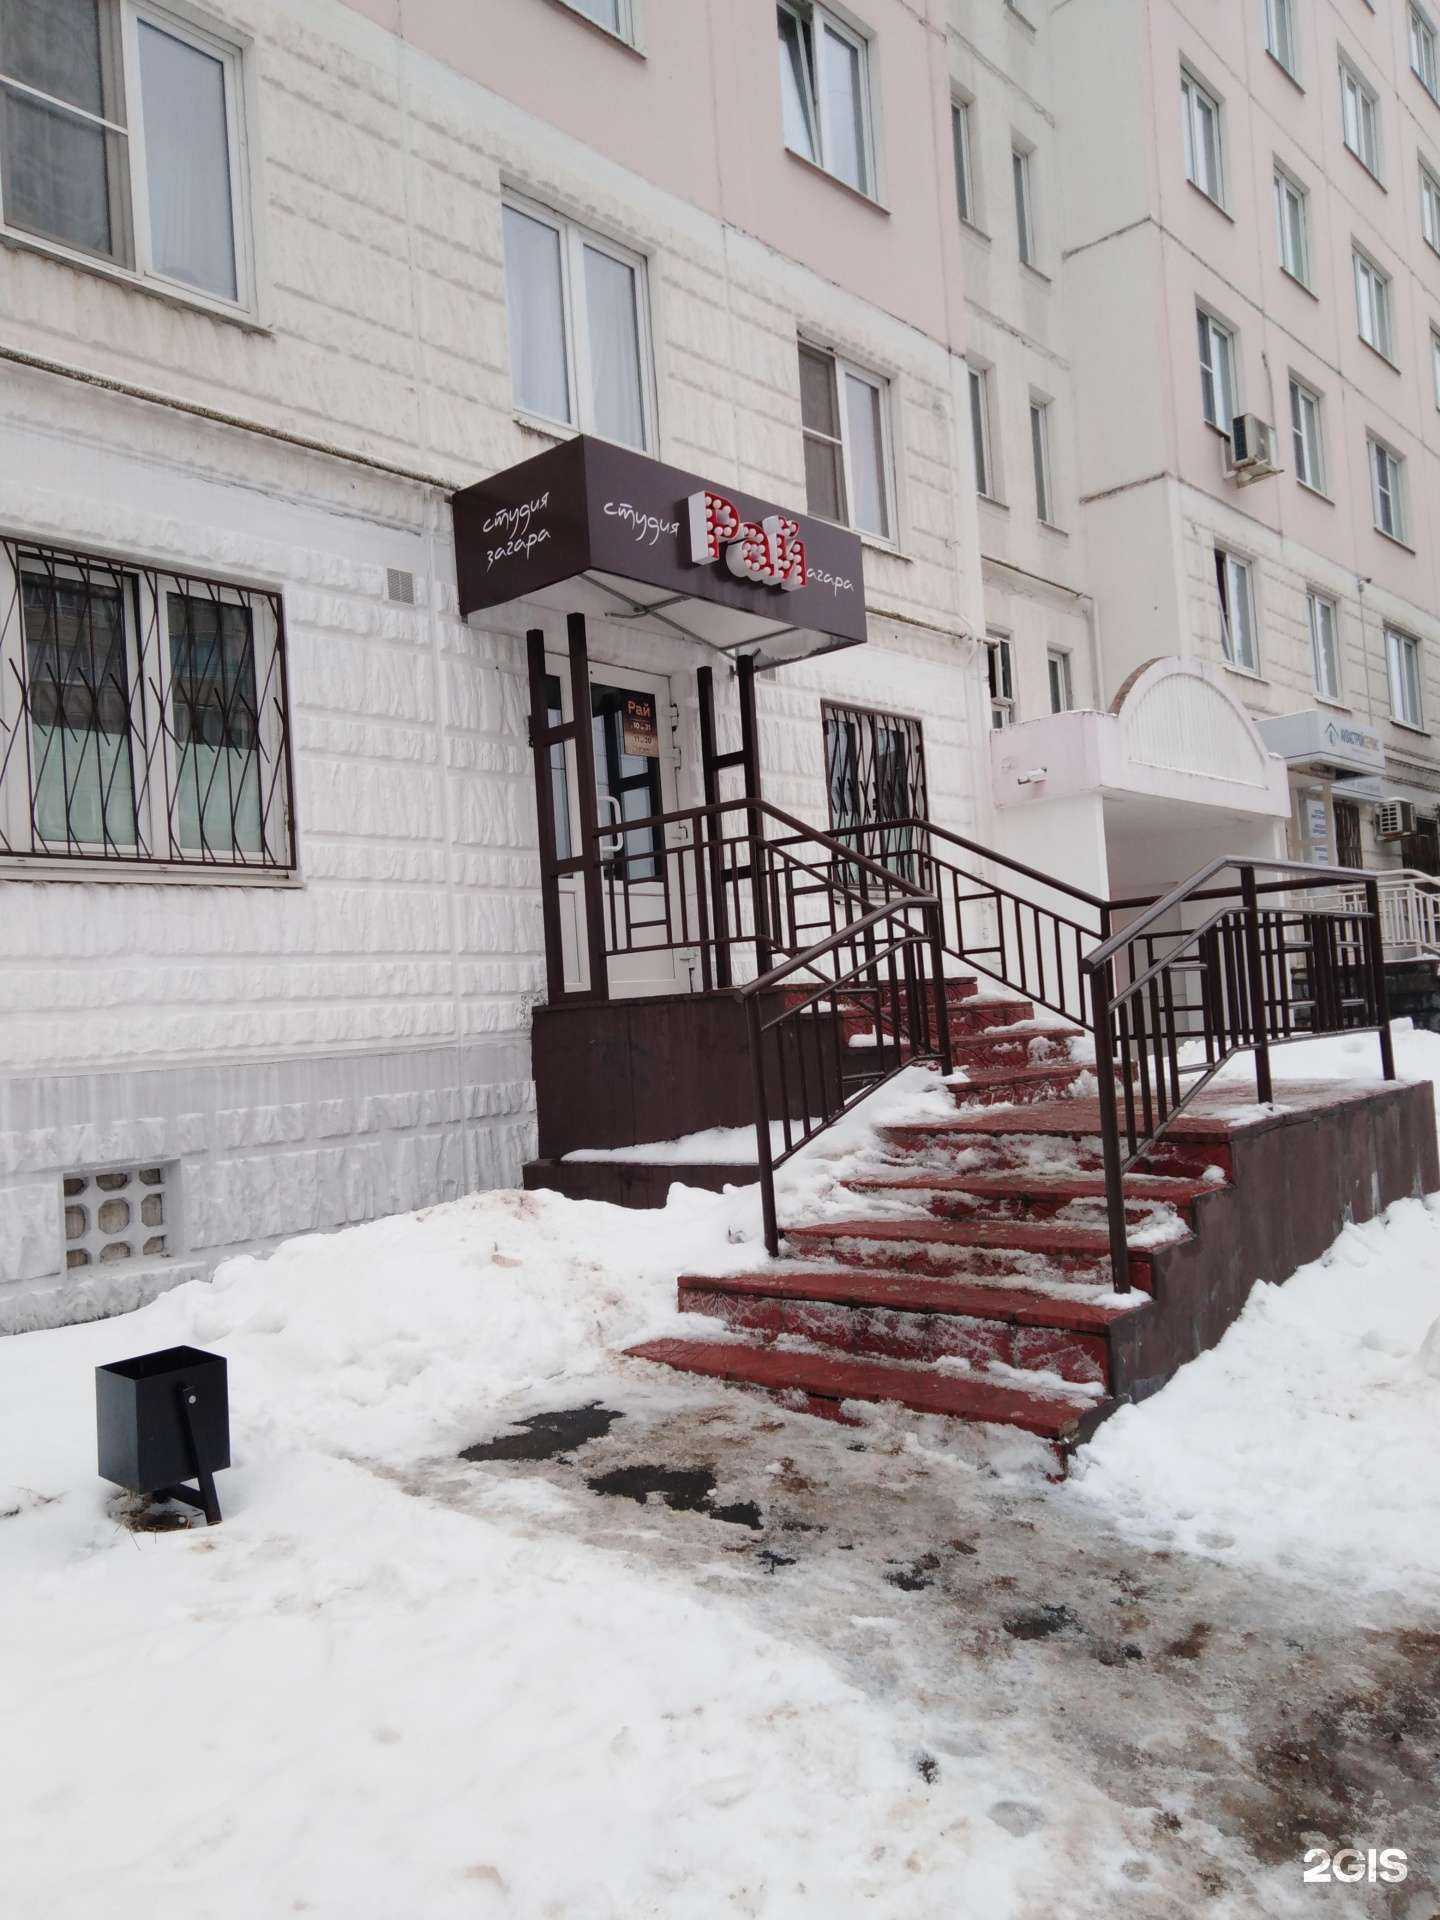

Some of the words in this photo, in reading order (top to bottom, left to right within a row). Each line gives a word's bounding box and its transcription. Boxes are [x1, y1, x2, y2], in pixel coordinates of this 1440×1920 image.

[482, 491, 550, 536] студия
[486, 529, 551, 573] загара
[603, 501, 680, 546] студия
[806, 567, 854, 597] агара
[688, 490, 807, 591] Рай
[628, 701, 650, 717] Рай
